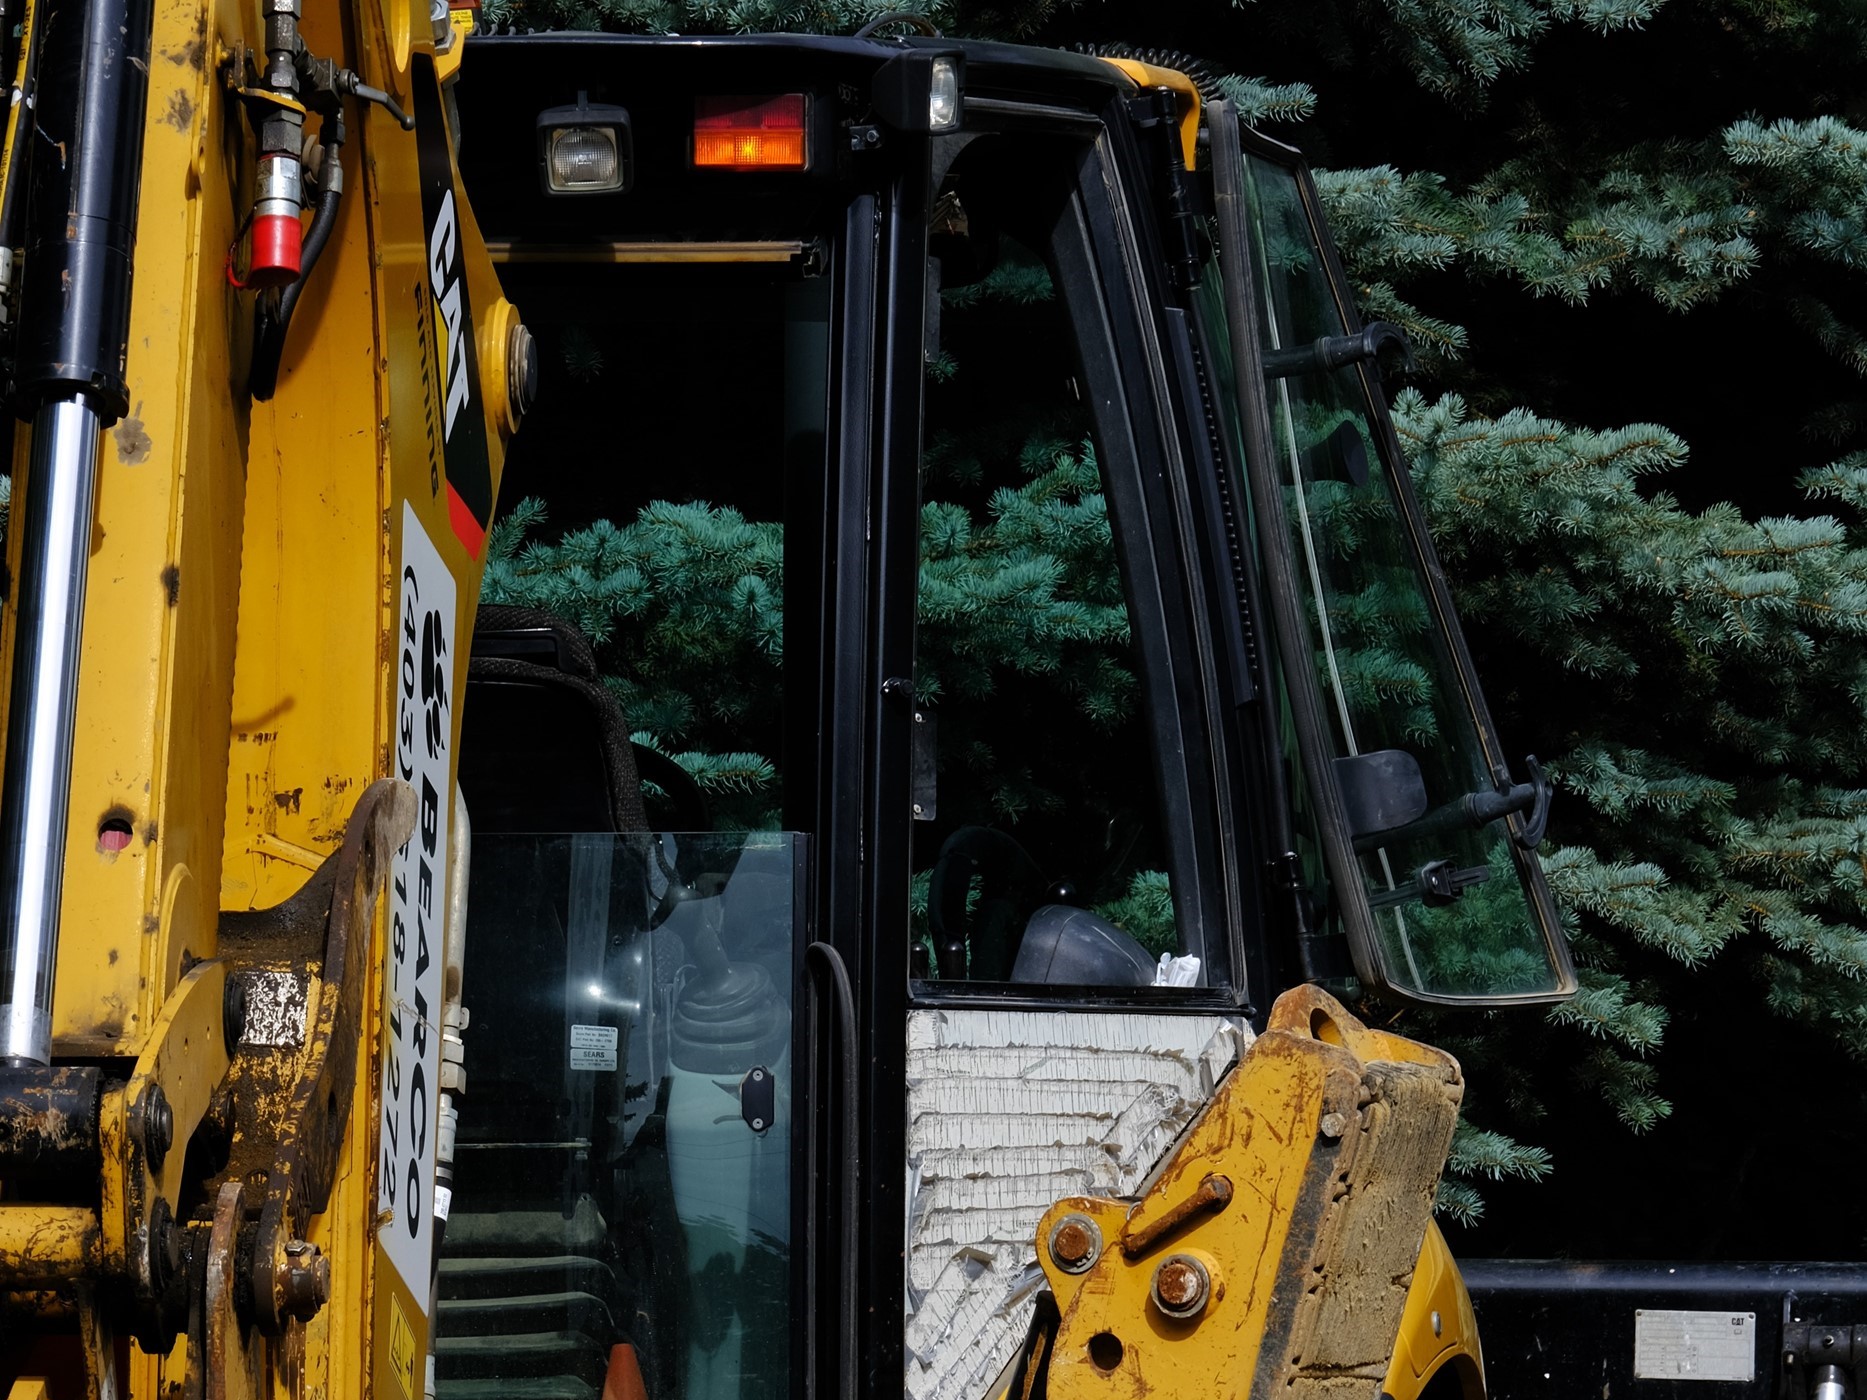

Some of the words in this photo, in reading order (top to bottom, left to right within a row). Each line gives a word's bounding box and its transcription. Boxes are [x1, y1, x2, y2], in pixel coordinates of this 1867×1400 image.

[414, 281, 438, 498] FINNING
[430, 188, 470, 445] CAT
[399, 565, 419, 782] (403)
[1731, 1317, 1745, 1326] CAT
